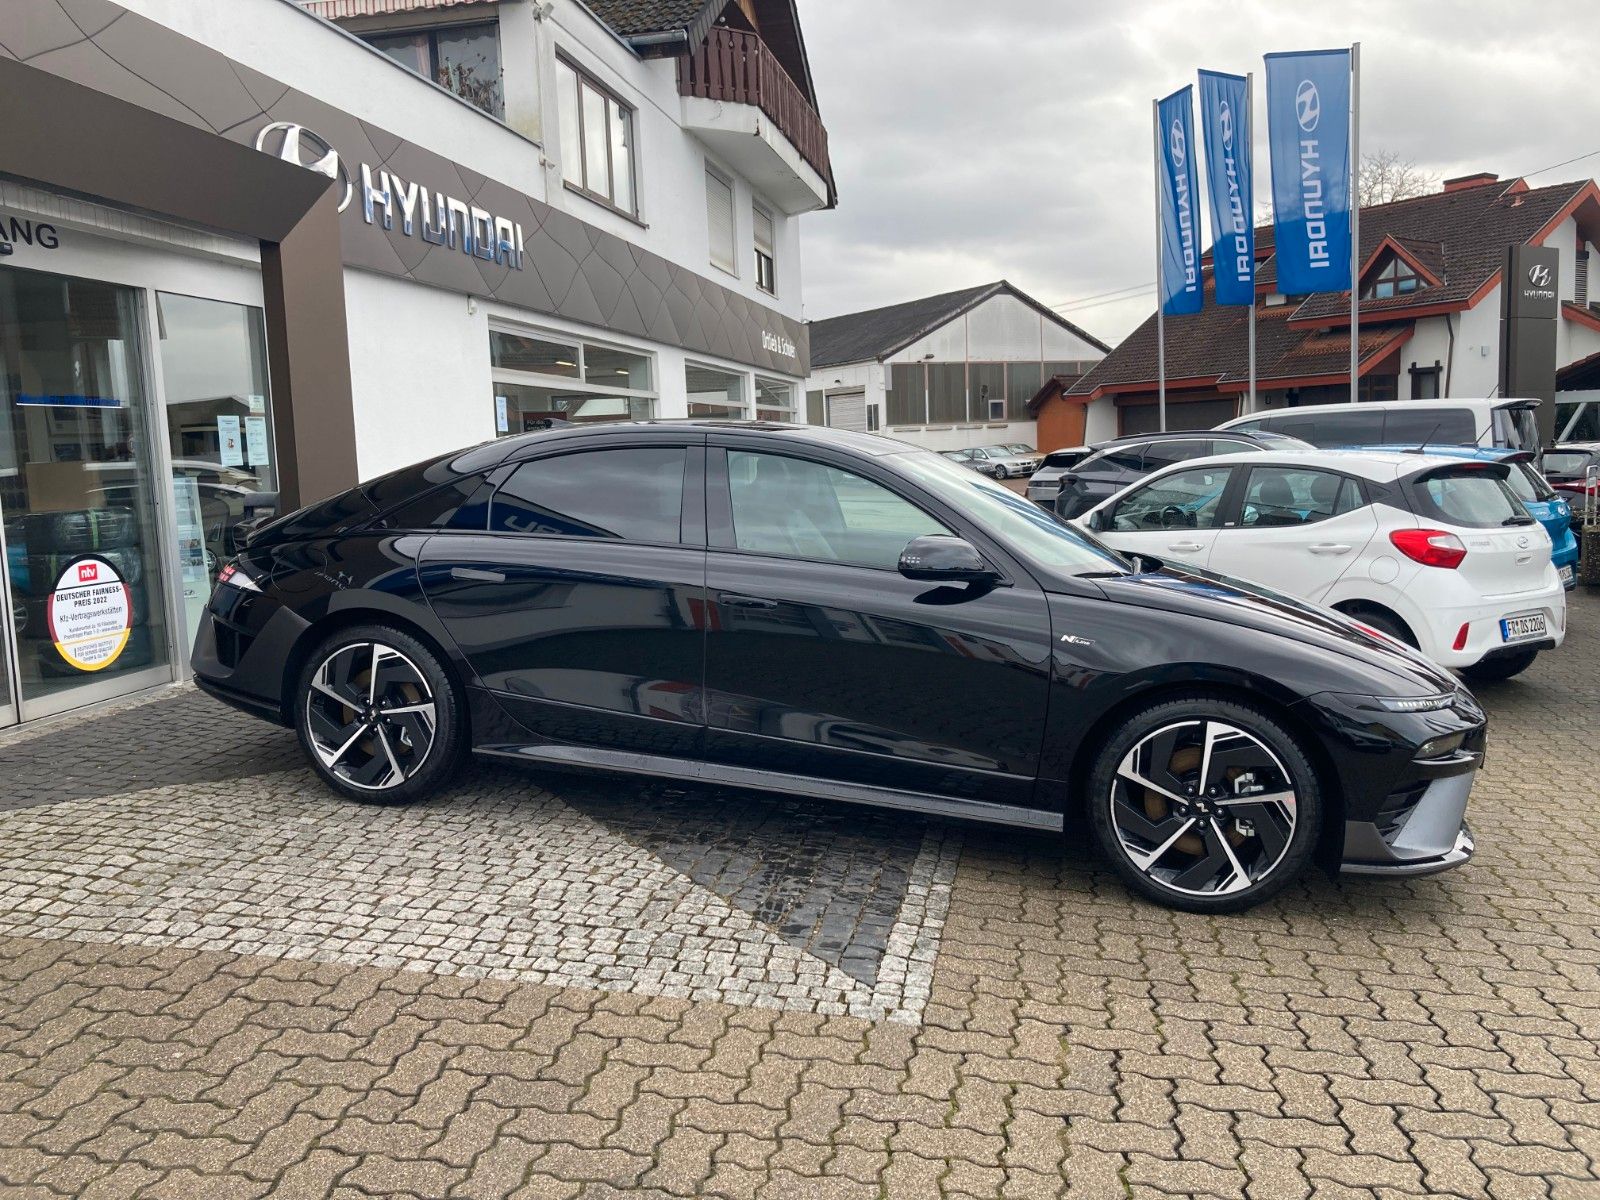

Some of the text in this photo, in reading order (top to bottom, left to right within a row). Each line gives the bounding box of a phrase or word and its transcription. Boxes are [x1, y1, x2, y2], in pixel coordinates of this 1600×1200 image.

[360, 162, 524, 271] HYUNDAI
[1175, 173, 1196, 293] HYUNDAI
[1524, 290, 1555, 299] HYUNDAI
[80, 566, 96, 579] ntv
[56, 585, 122, 602] DEUTSCHER FAIRNESS-
[74, 596, 108, 608] PREIS 2022
[1507, 616, 1545, 637] FR DS 2206
